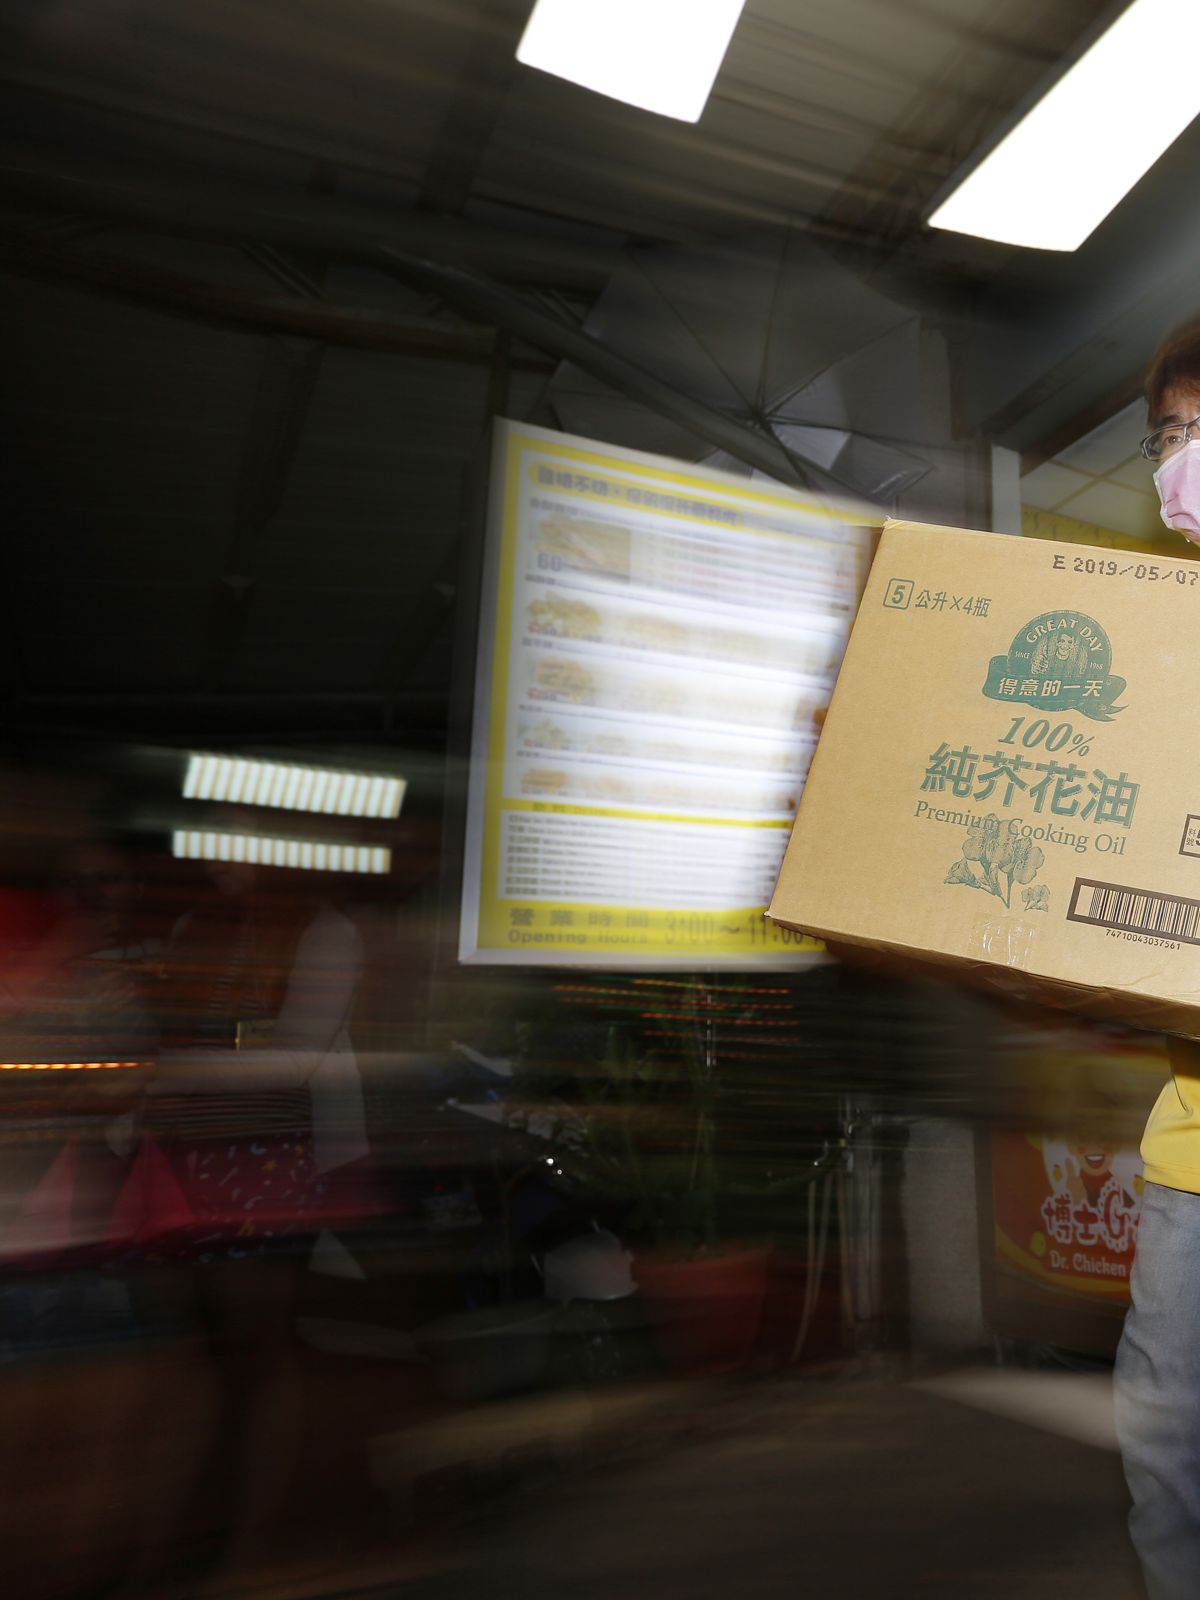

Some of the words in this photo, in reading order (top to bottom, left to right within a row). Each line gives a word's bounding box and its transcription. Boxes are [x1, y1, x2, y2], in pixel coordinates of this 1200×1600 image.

[1052, 554, 1067, 571] E
[1073, 556, 1200, 587] 2019/05/07
[1026, 618, 1079, 643] GREAT
[1079, 625, 1104, 652] DAY
[998, 677, 1104, 697] 得意的一天
[997, 716, 1096, 757] 100%
[919, 741, 1141, 830] 純芥花油
[913, 800, 1001, 834] Premium
[1007, 817, 1090, 854] Cooking
[1094, 833, 1127, 856] Oil
[1105, 928, 1182, 951] 74710043037561
[1051, 1251, 1069, 1270] Dr.
[1073, 1254, 1126, 1277] Chicken
